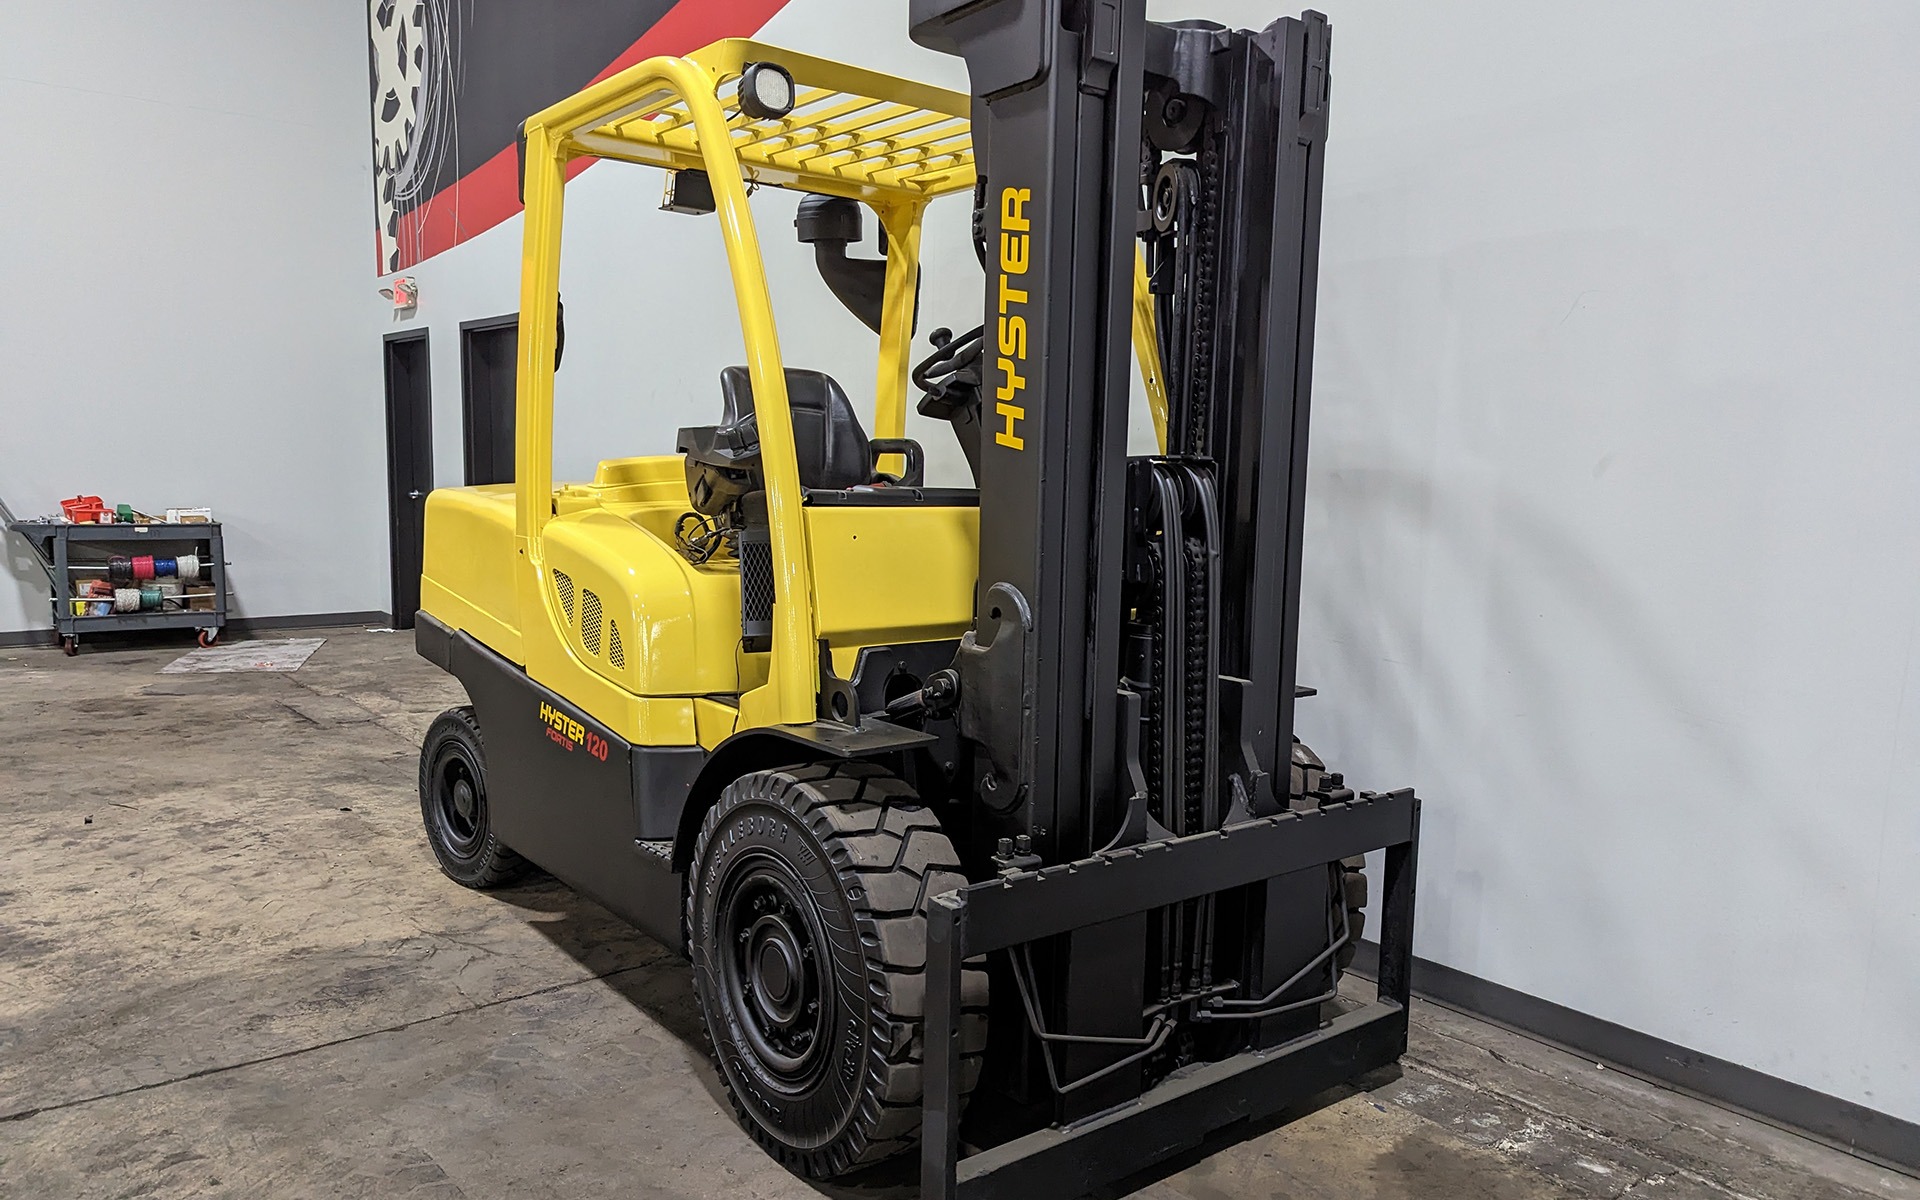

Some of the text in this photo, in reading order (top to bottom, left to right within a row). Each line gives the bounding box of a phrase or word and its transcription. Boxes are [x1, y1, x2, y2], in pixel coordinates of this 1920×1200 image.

[995, 186, 1031, 451] HYSTER
[540, 701, 609, 762] HYSTER 120
[545, 726, 574, 752] FORTIS
